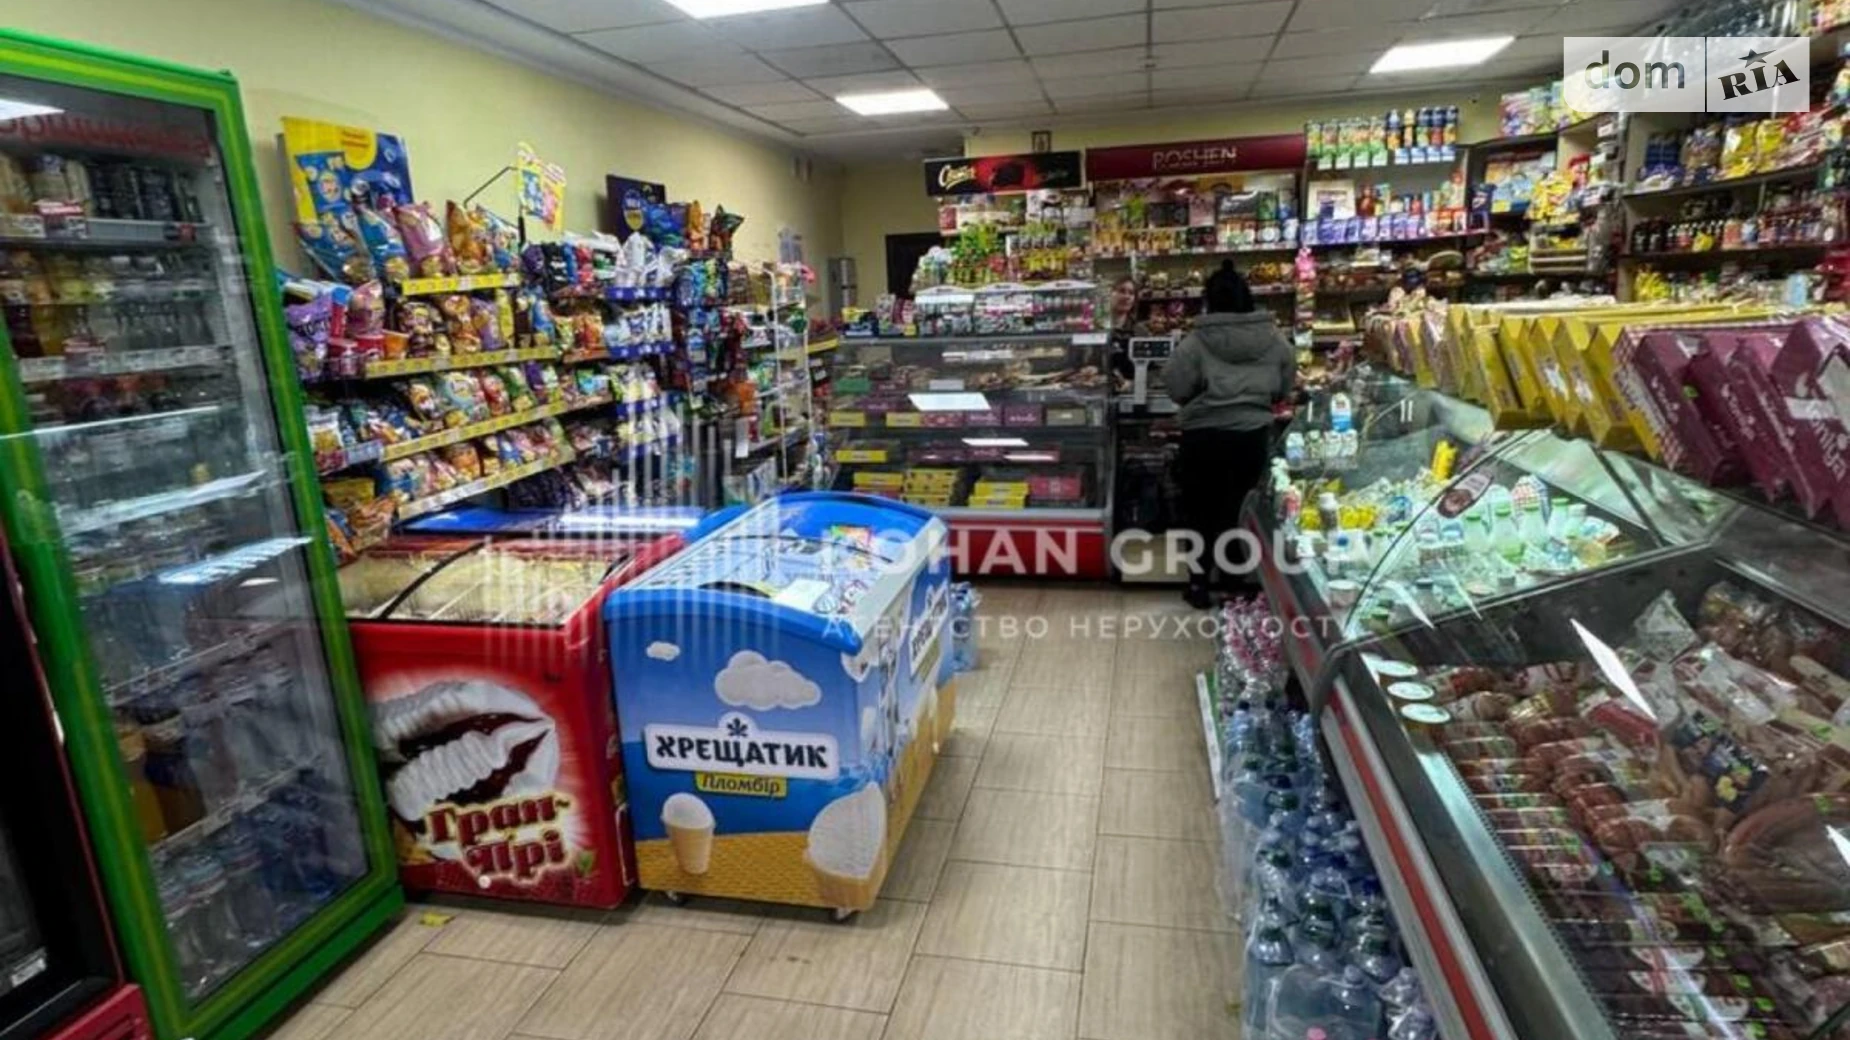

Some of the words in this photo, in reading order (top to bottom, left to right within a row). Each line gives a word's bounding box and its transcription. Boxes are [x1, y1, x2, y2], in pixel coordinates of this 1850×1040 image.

[656, 735, 828, 768] ХРЕЩАТИК
[701, 773, 781, 795] Пломбір
[429, 796, 570, 848] Гран-
